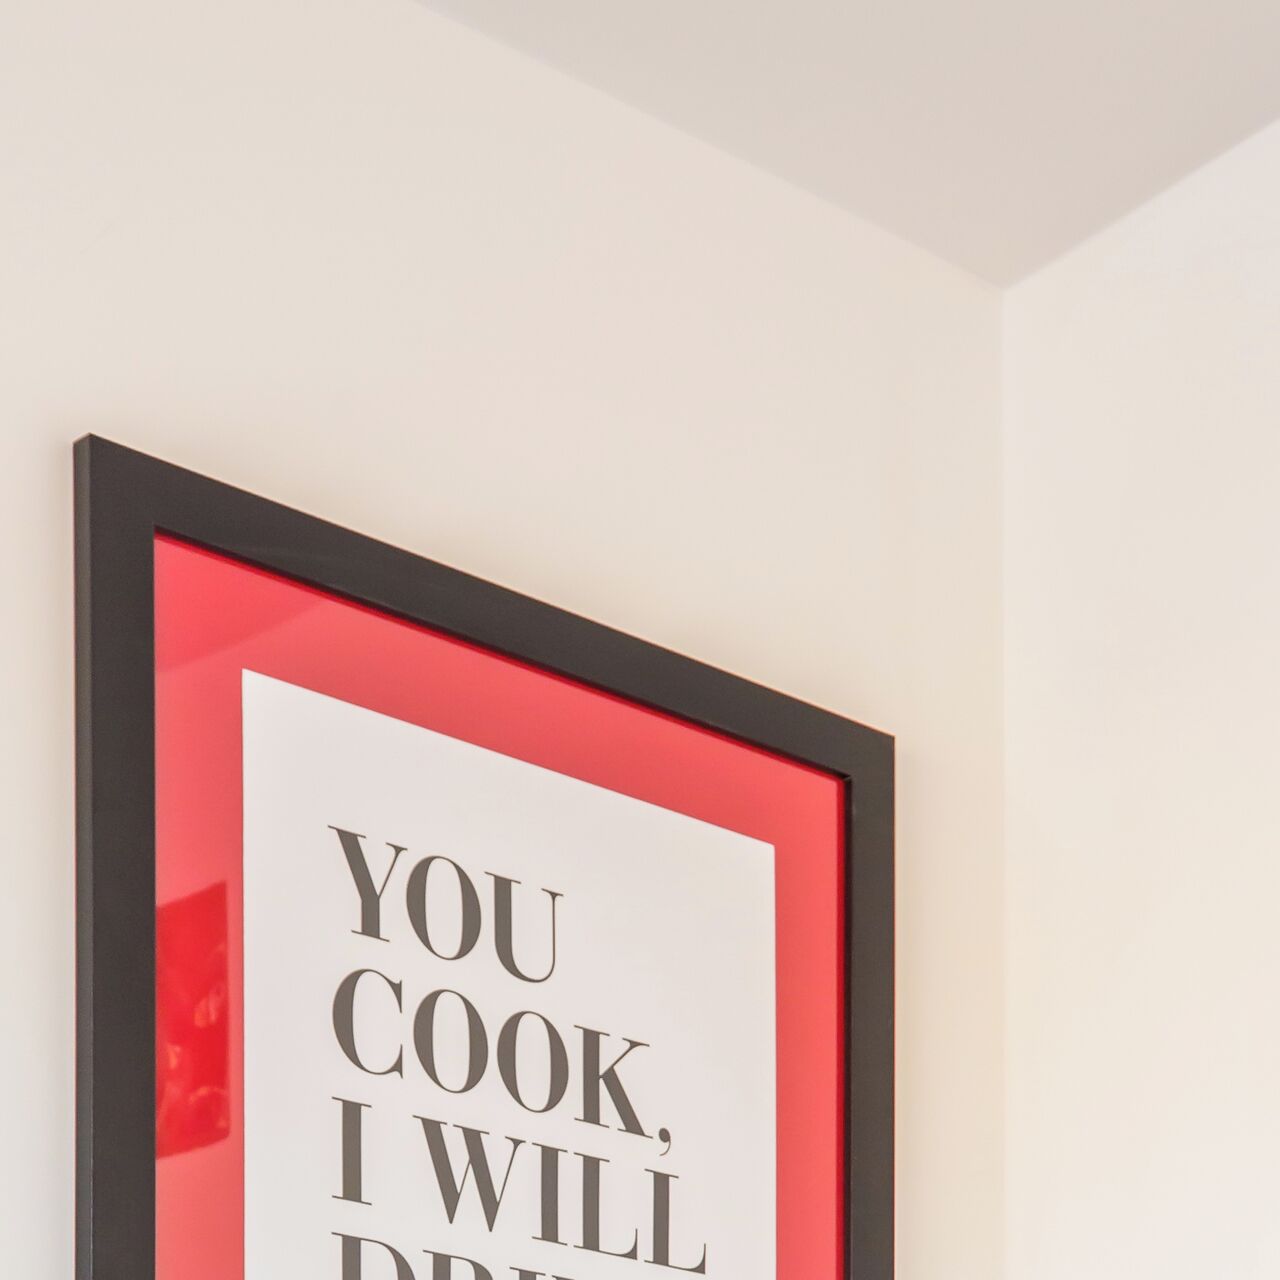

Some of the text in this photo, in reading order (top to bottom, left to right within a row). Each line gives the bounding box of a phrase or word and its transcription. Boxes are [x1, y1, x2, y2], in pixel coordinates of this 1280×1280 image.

[327, 825, 564, 984] YOU
[332, 968, 671, 1157] COOK,
[331, 1096, 707, 1275] I WILL
